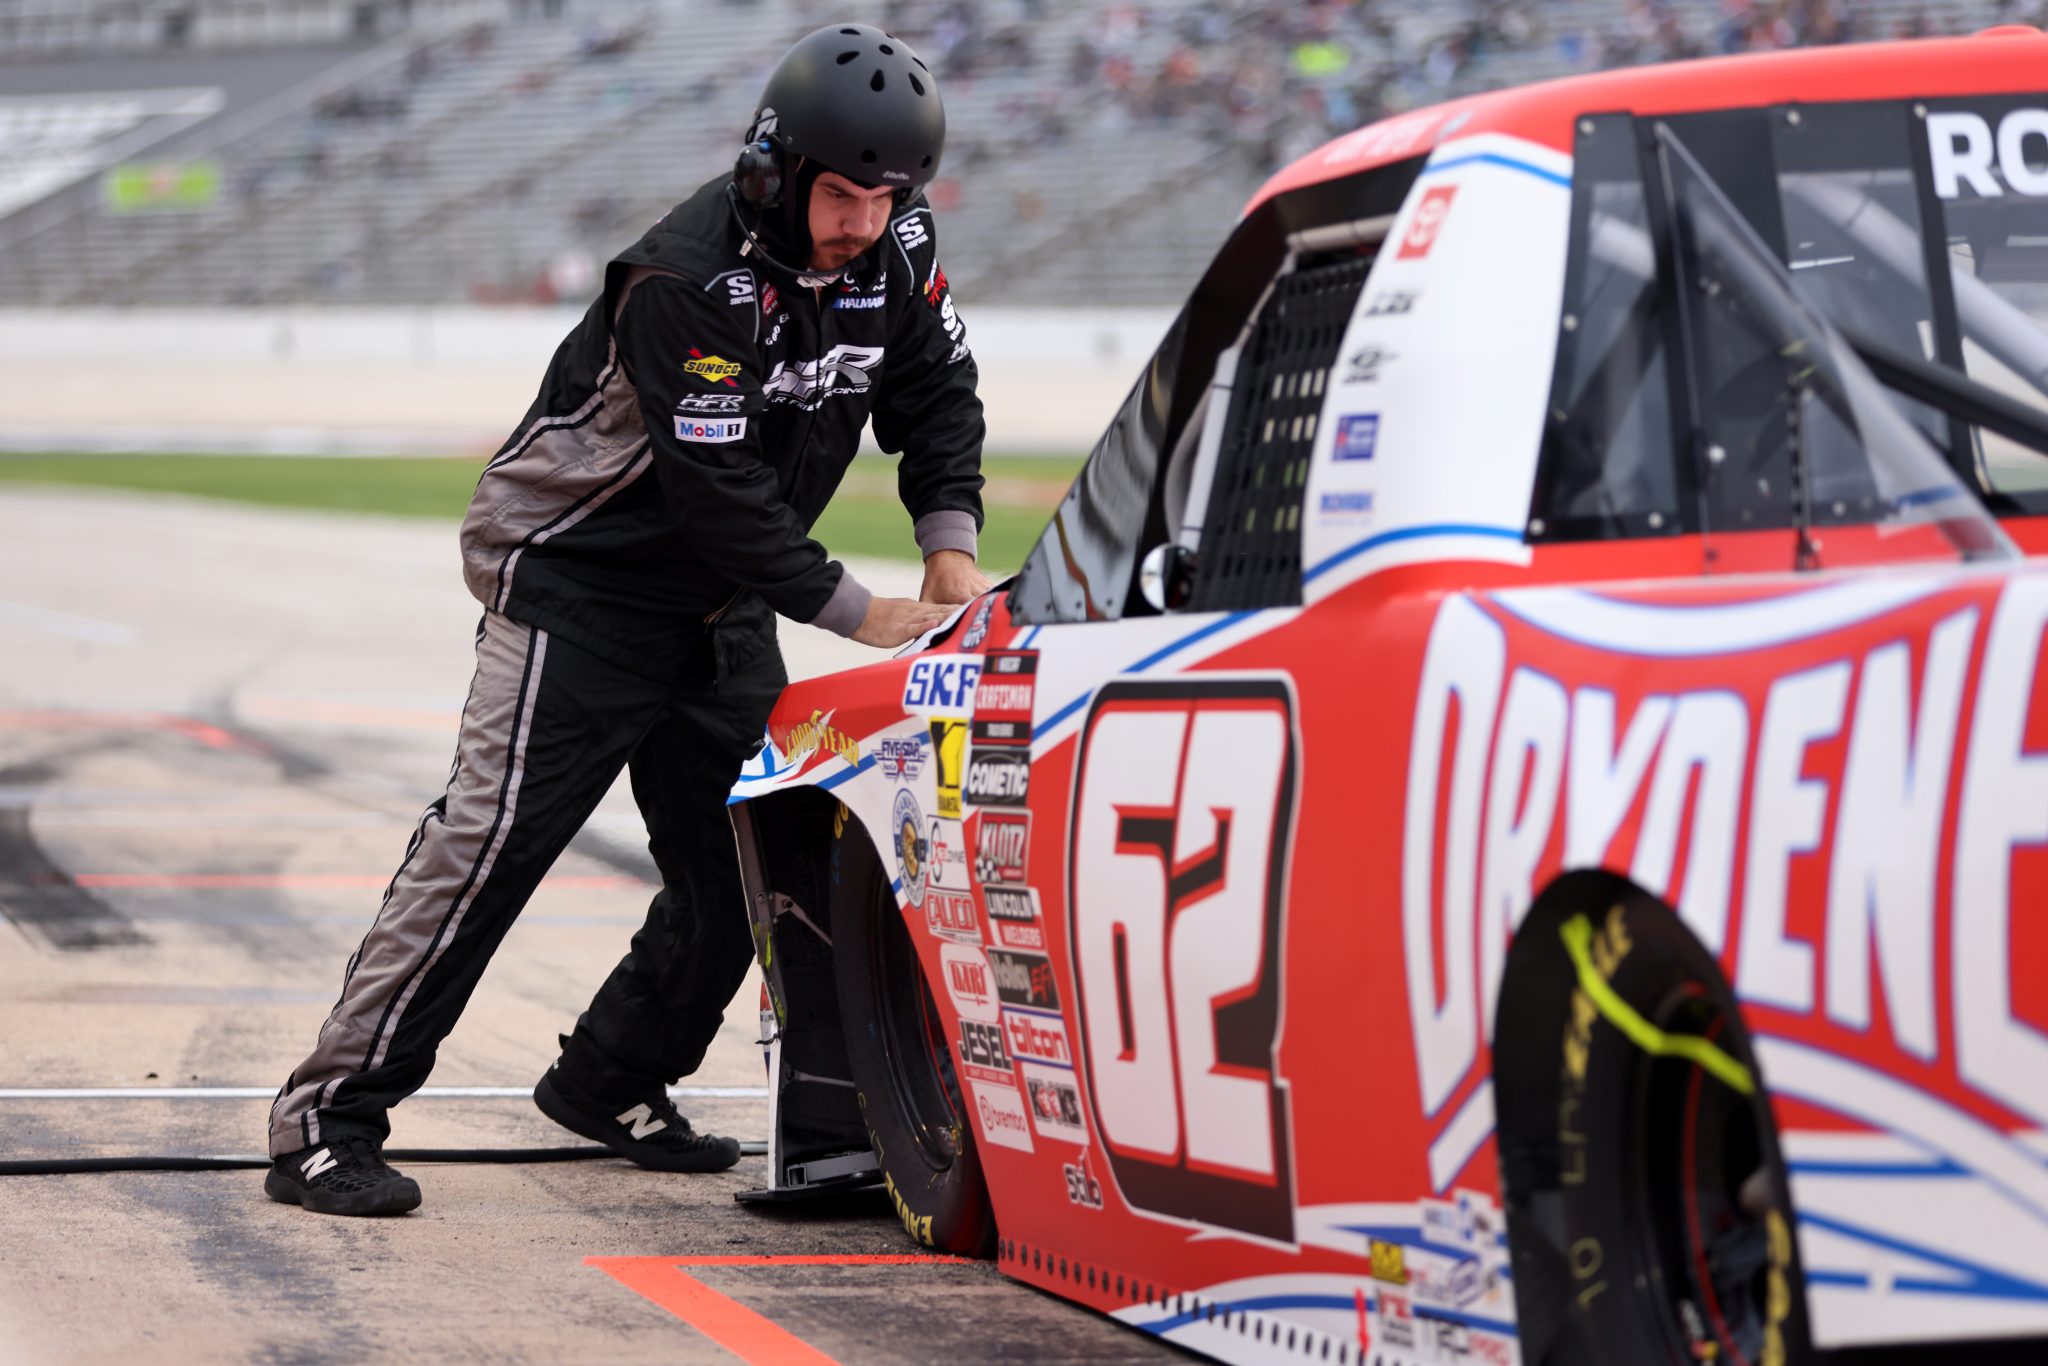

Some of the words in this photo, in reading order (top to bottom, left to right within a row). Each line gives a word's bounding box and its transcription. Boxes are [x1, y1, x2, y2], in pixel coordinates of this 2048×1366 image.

[685, 360, 740, 375] SUNOCO
[680, 421, 724, 438] Mobil
[727, 423, 741, 437] 1
[904, 662, 980, 708] SKF
[976, 684, 1033, 711] CRAFTSMAN
[968, 762, 1030, 797] COMETIC
[980, 821, 1027, 867] KLOTZ
[926, 892, 977, 932] CALICO
[985, 891, 1035, 918] LINCOLN
[1071, 698, 1291, 1190] 62
[959, 1020, 1013, 1071] JESEL
[616, 1102, 667, 1140] N
[301, 1147, 338, 1181] N
